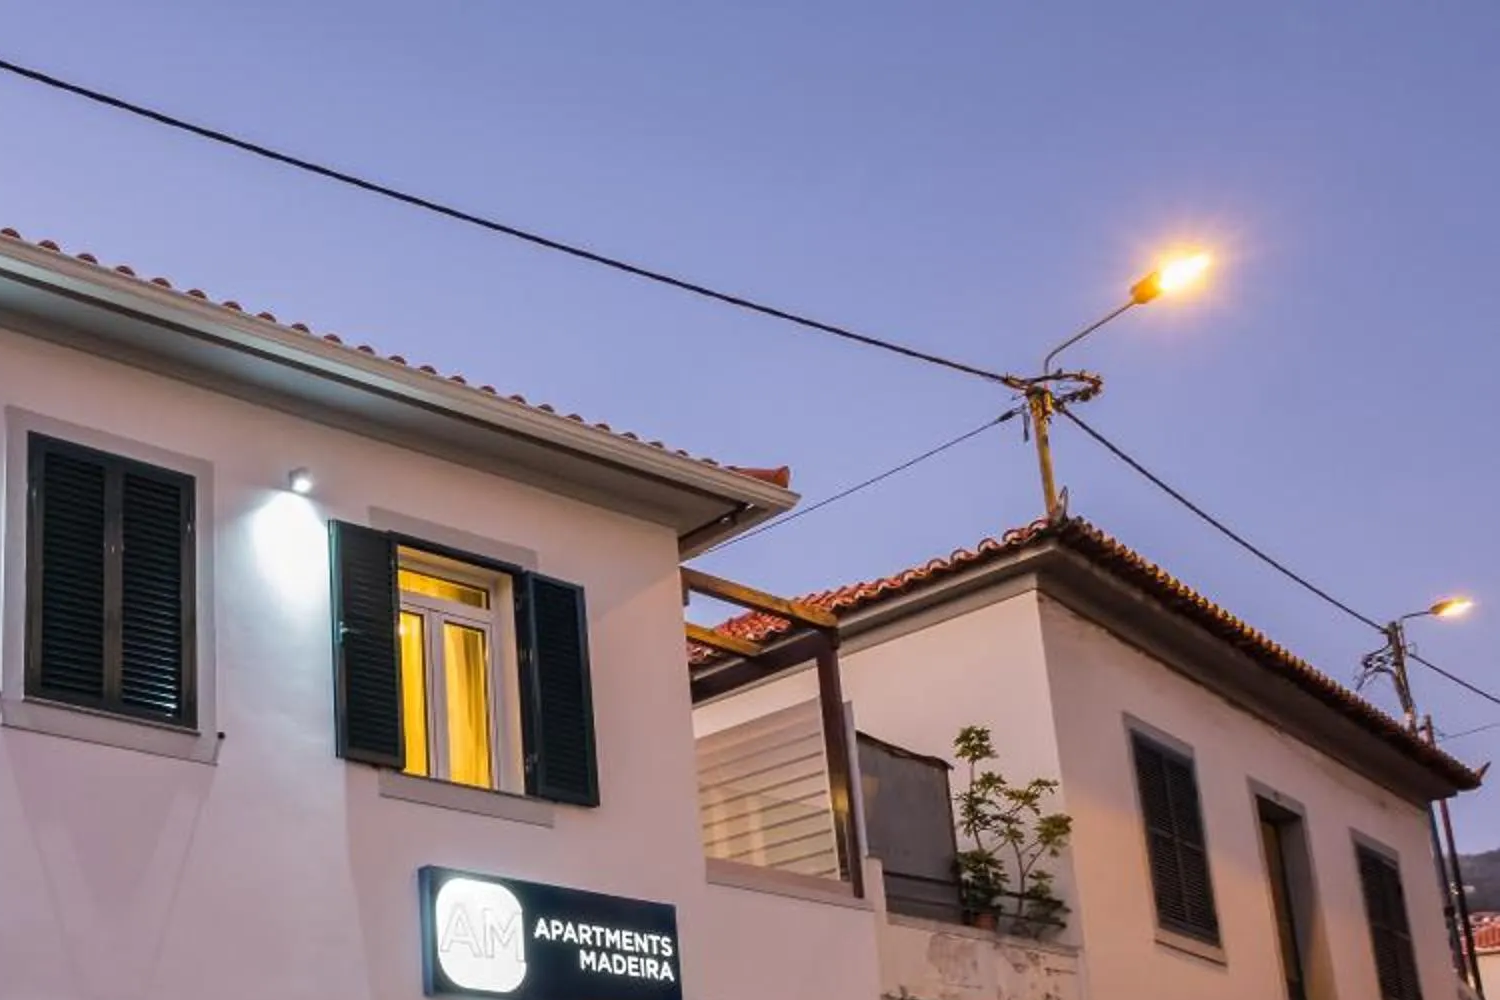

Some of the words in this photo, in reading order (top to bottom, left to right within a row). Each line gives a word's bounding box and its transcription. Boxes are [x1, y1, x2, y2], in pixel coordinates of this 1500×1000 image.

[439, 902, 525, 962] AM
[534, 917, 673, 956] APARTMENTS
[579, 949, 675, 982] MADEIRA
